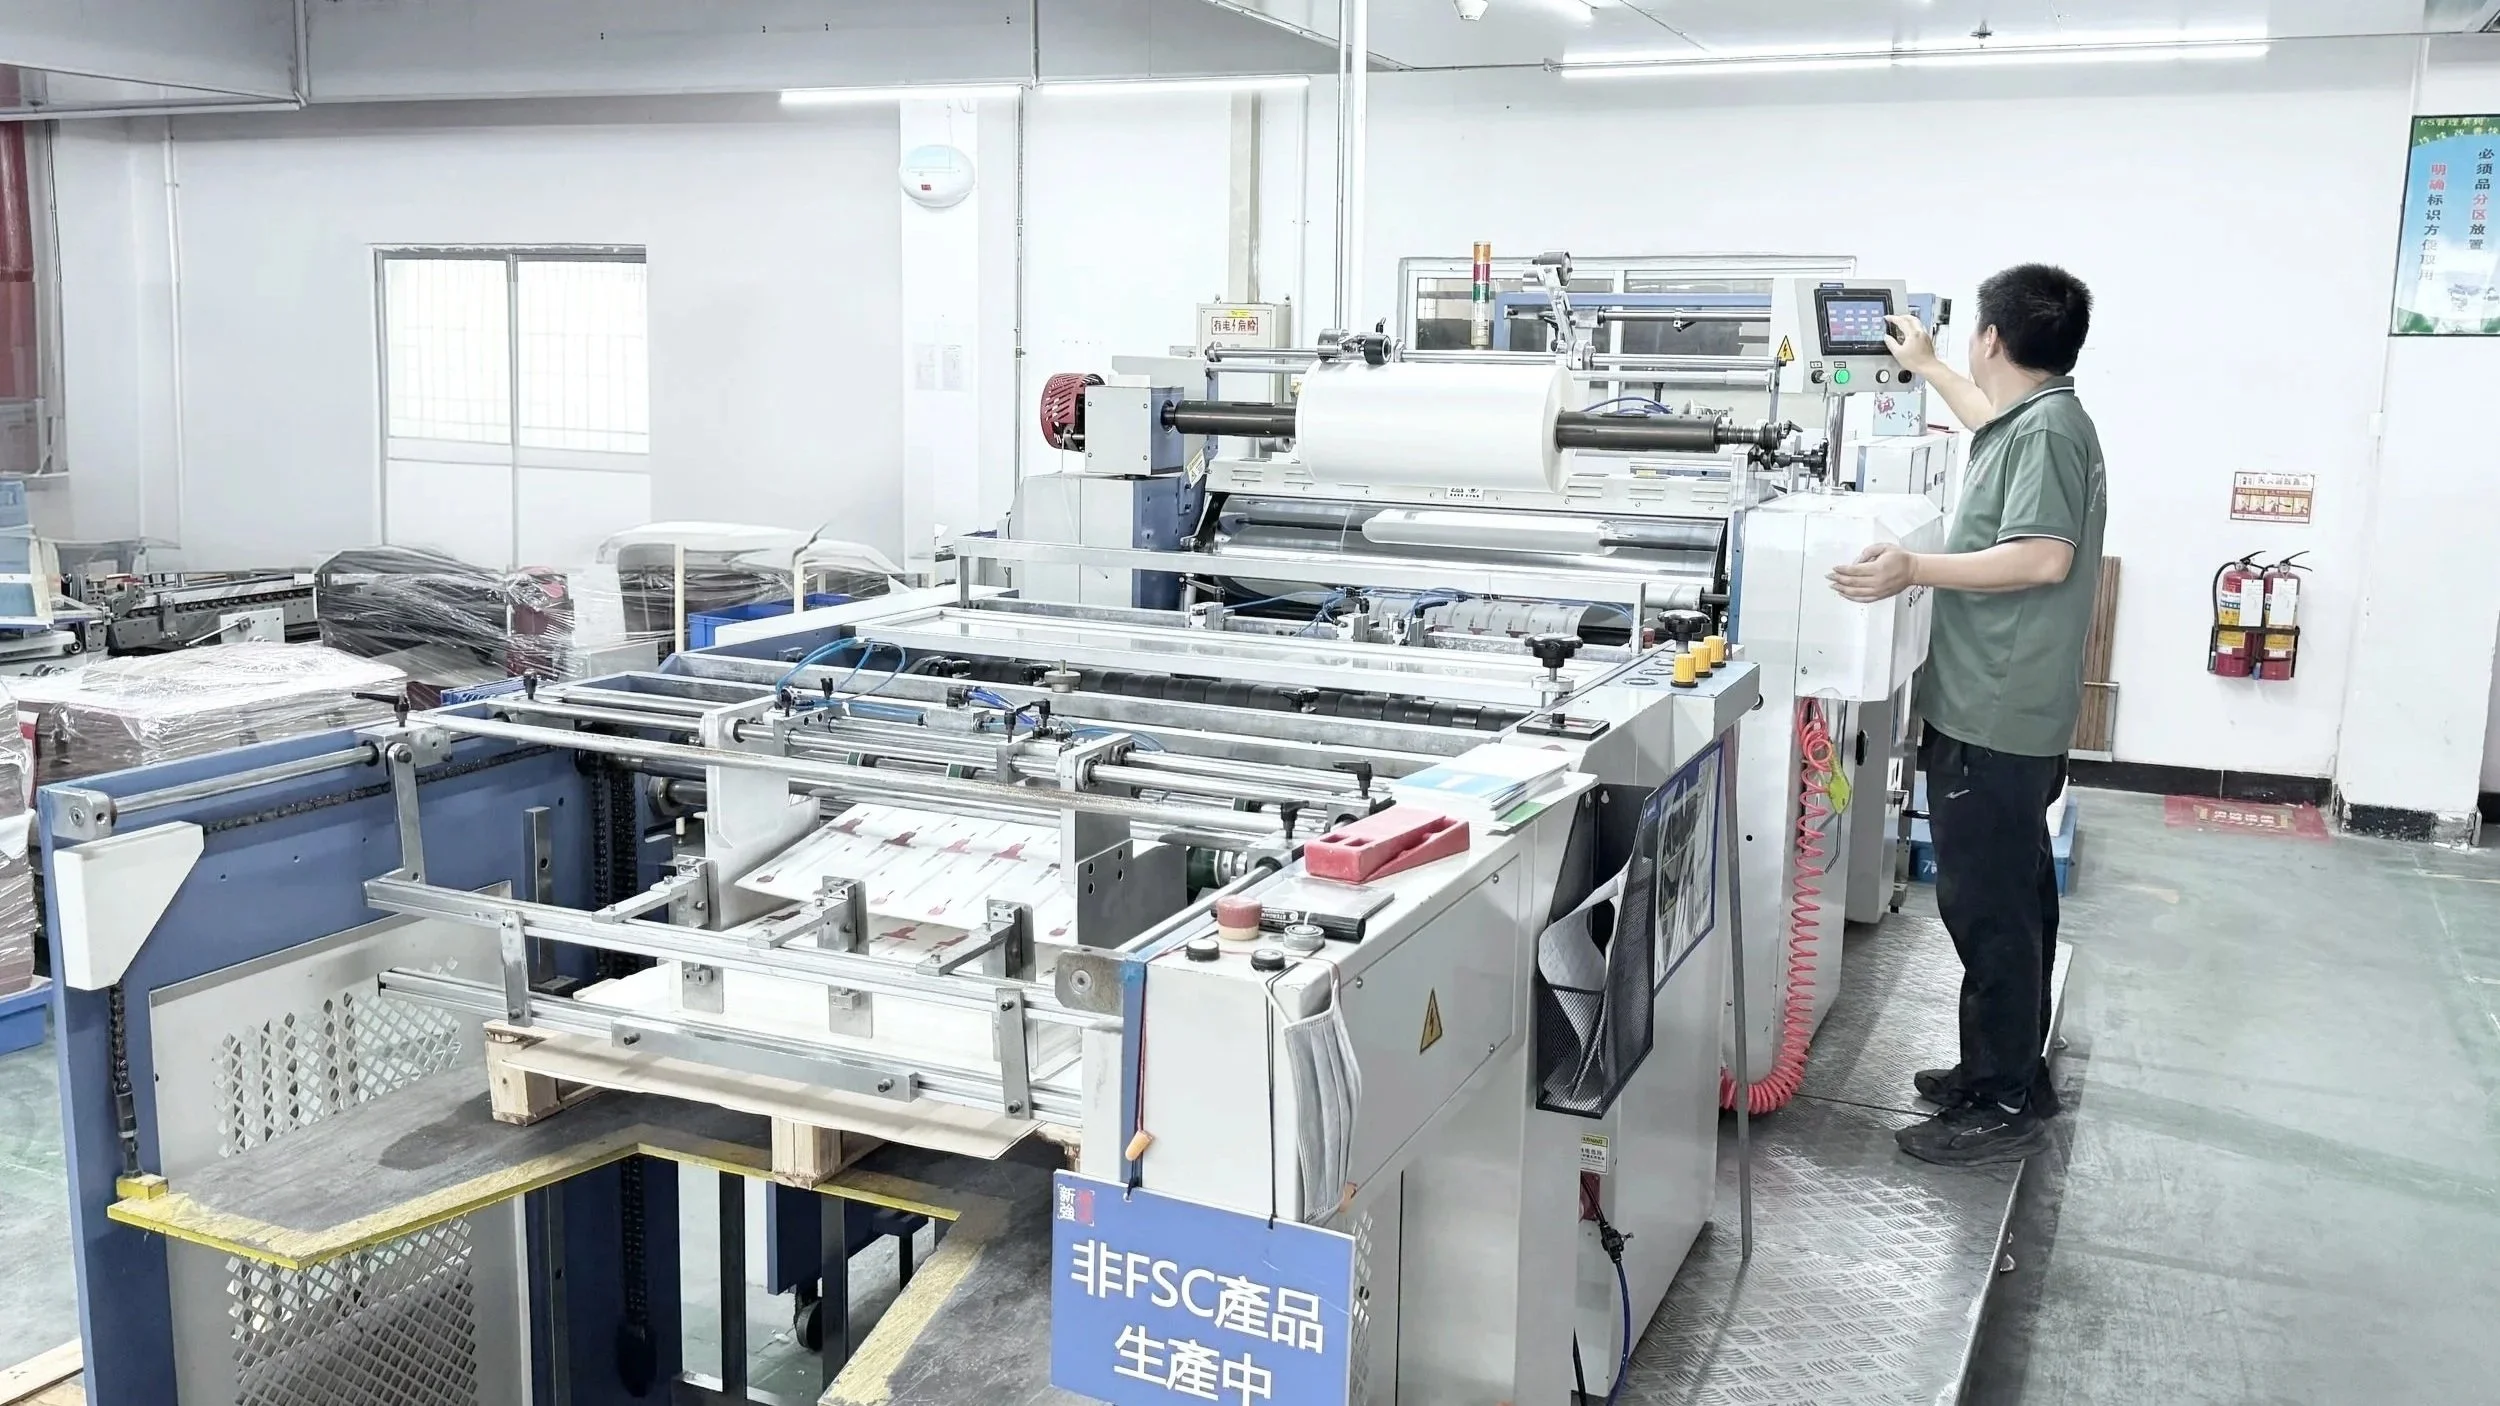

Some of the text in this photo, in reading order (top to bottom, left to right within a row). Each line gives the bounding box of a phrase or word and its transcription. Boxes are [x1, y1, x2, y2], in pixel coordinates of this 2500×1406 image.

[2418, 163, 2447, 281] 明确标识方便取用
[2468, 148, 2495, 250] 必须品分区放置
[1071, 1239, 1324, 1354] 非FSC產品
[1114, 1325, 1272, 1406] 生產中
